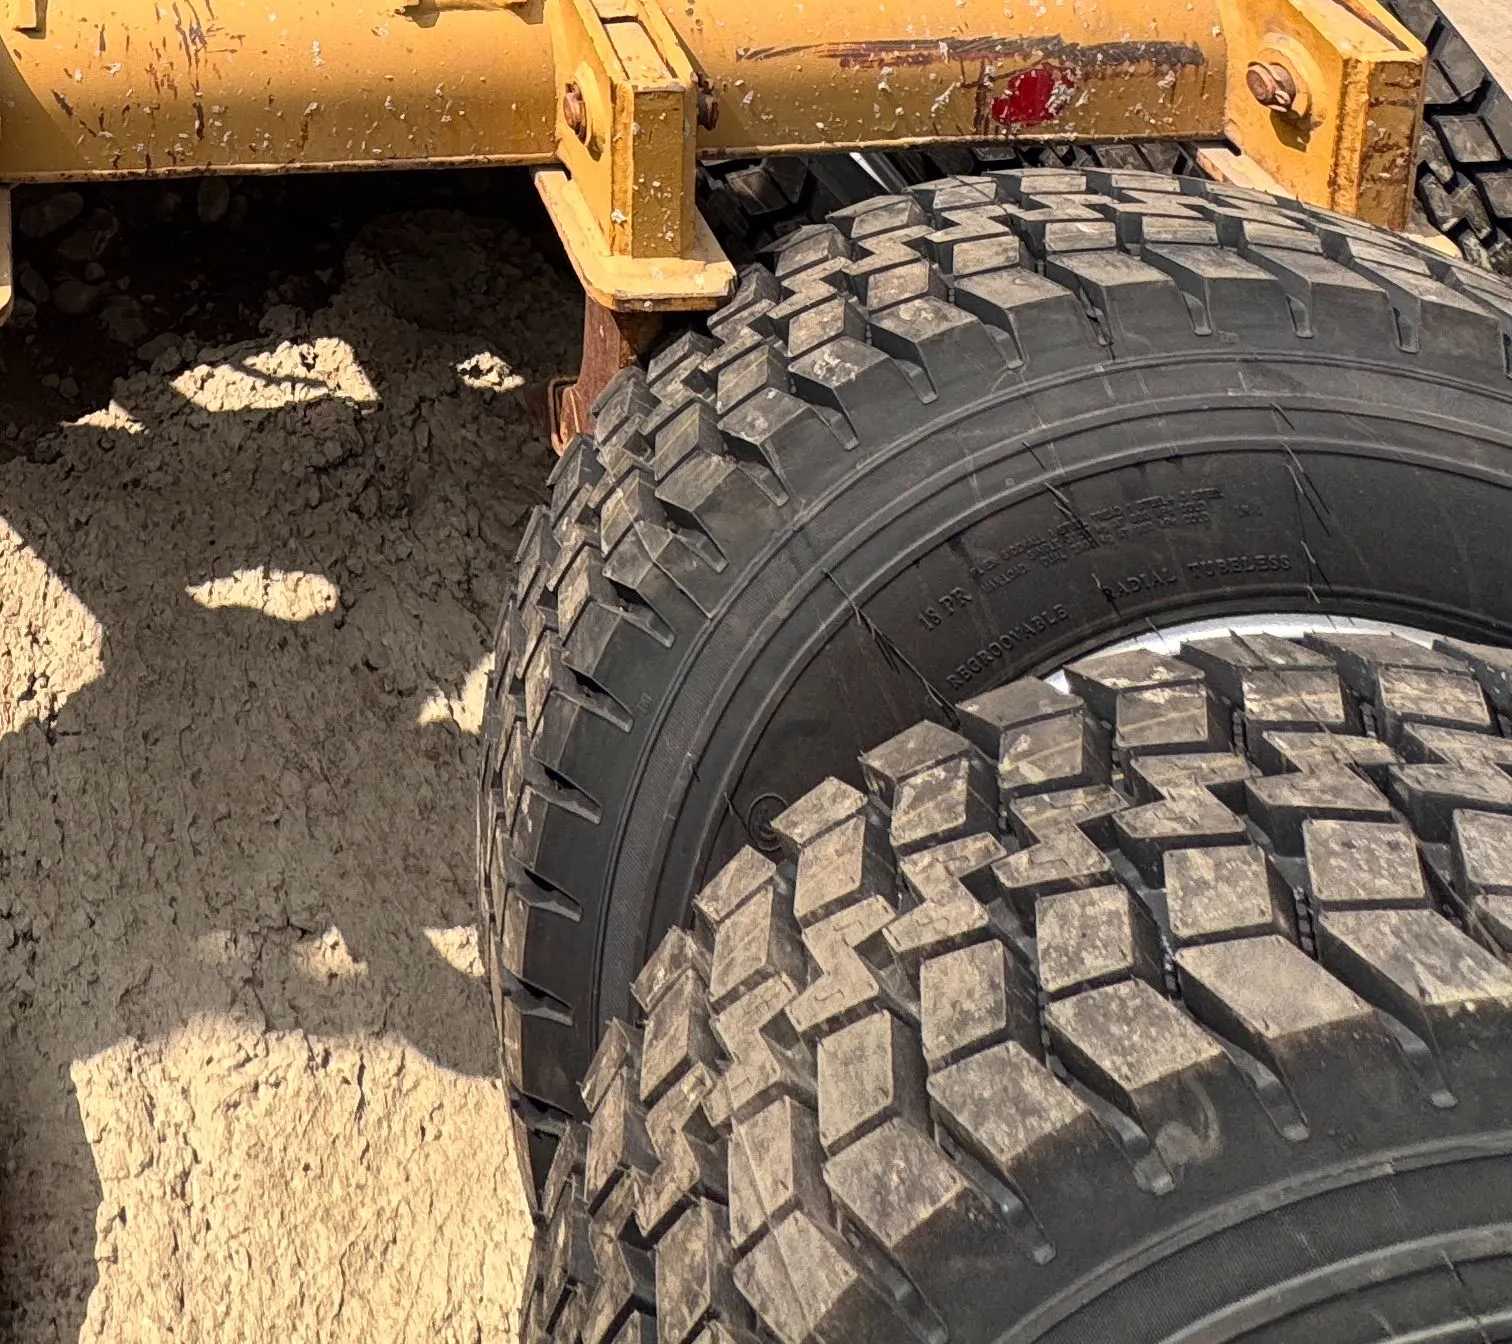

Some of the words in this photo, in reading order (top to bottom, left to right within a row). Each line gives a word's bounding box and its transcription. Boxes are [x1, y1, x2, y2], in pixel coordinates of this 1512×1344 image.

[1187, 554, 1291, 581] TUBELESS
[938, 586, 974, 616] PR
[1102, 567, 1178, 603] RADIAL
[945, 602, 1070, 691] REGROOVABLE
